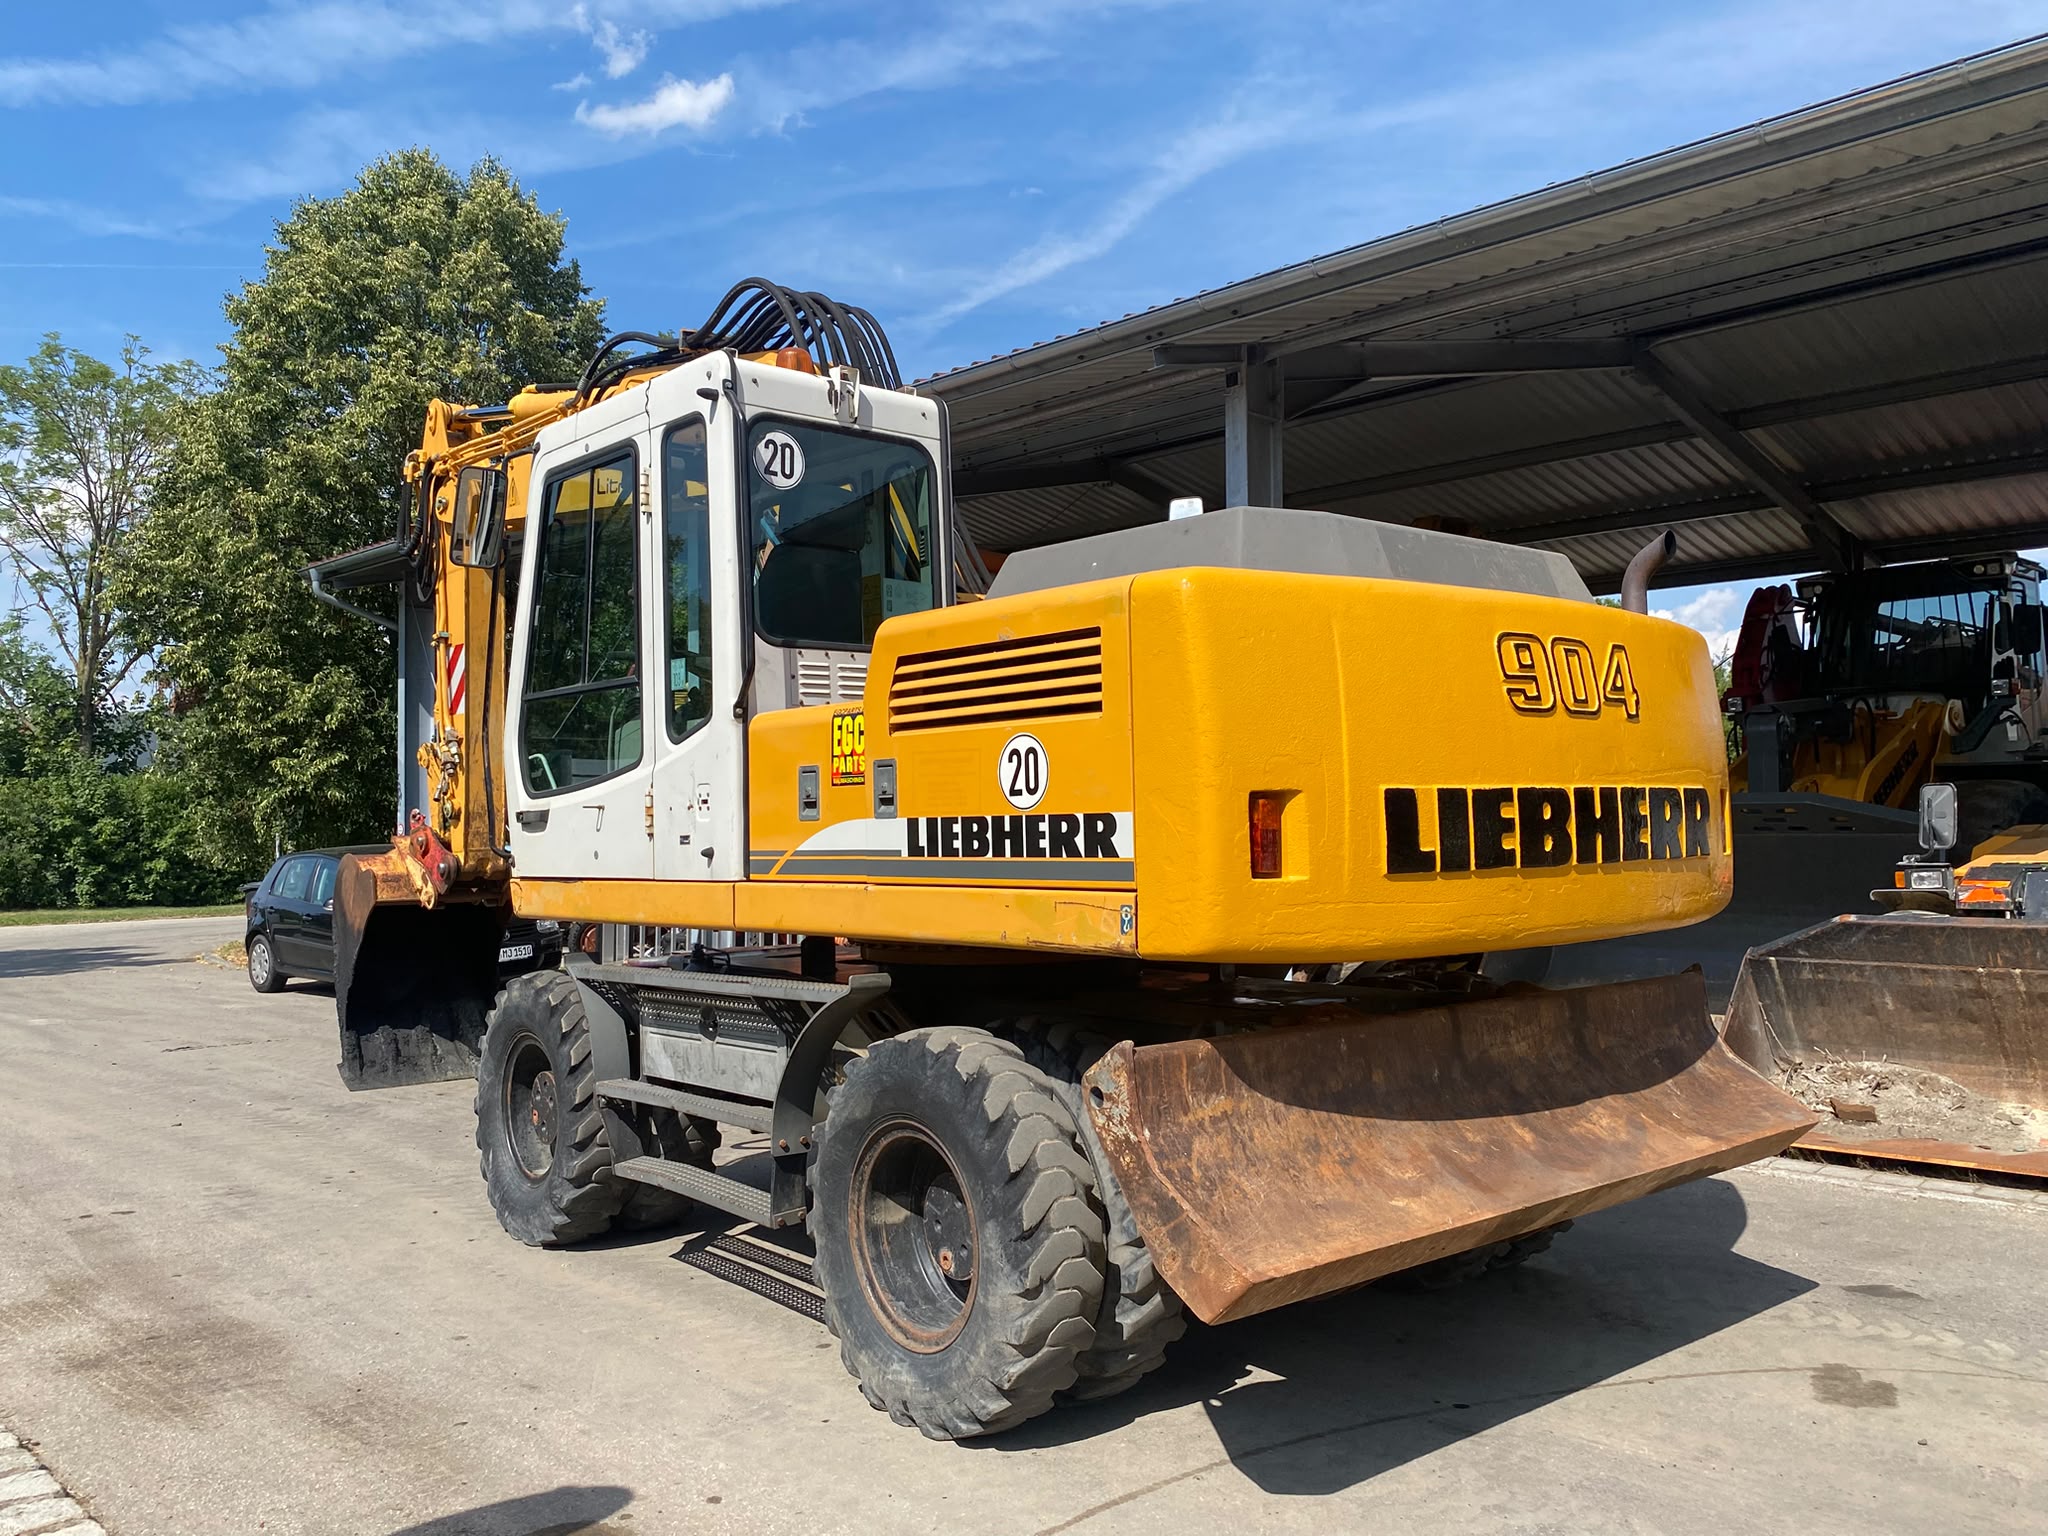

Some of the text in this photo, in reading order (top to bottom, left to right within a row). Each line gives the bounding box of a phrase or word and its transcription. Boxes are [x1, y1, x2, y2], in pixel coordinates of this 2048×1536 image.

[763, 438, 795, 480] 20
[1496, 631, 1641, 721] 904
[833, 755, 866, 773] PARTS
[1007, 746, 1040, 797] 20
[906, 812, 1120, 858] LIEBHERR
[1384, 786, 1711, 875] LIEBHERR
